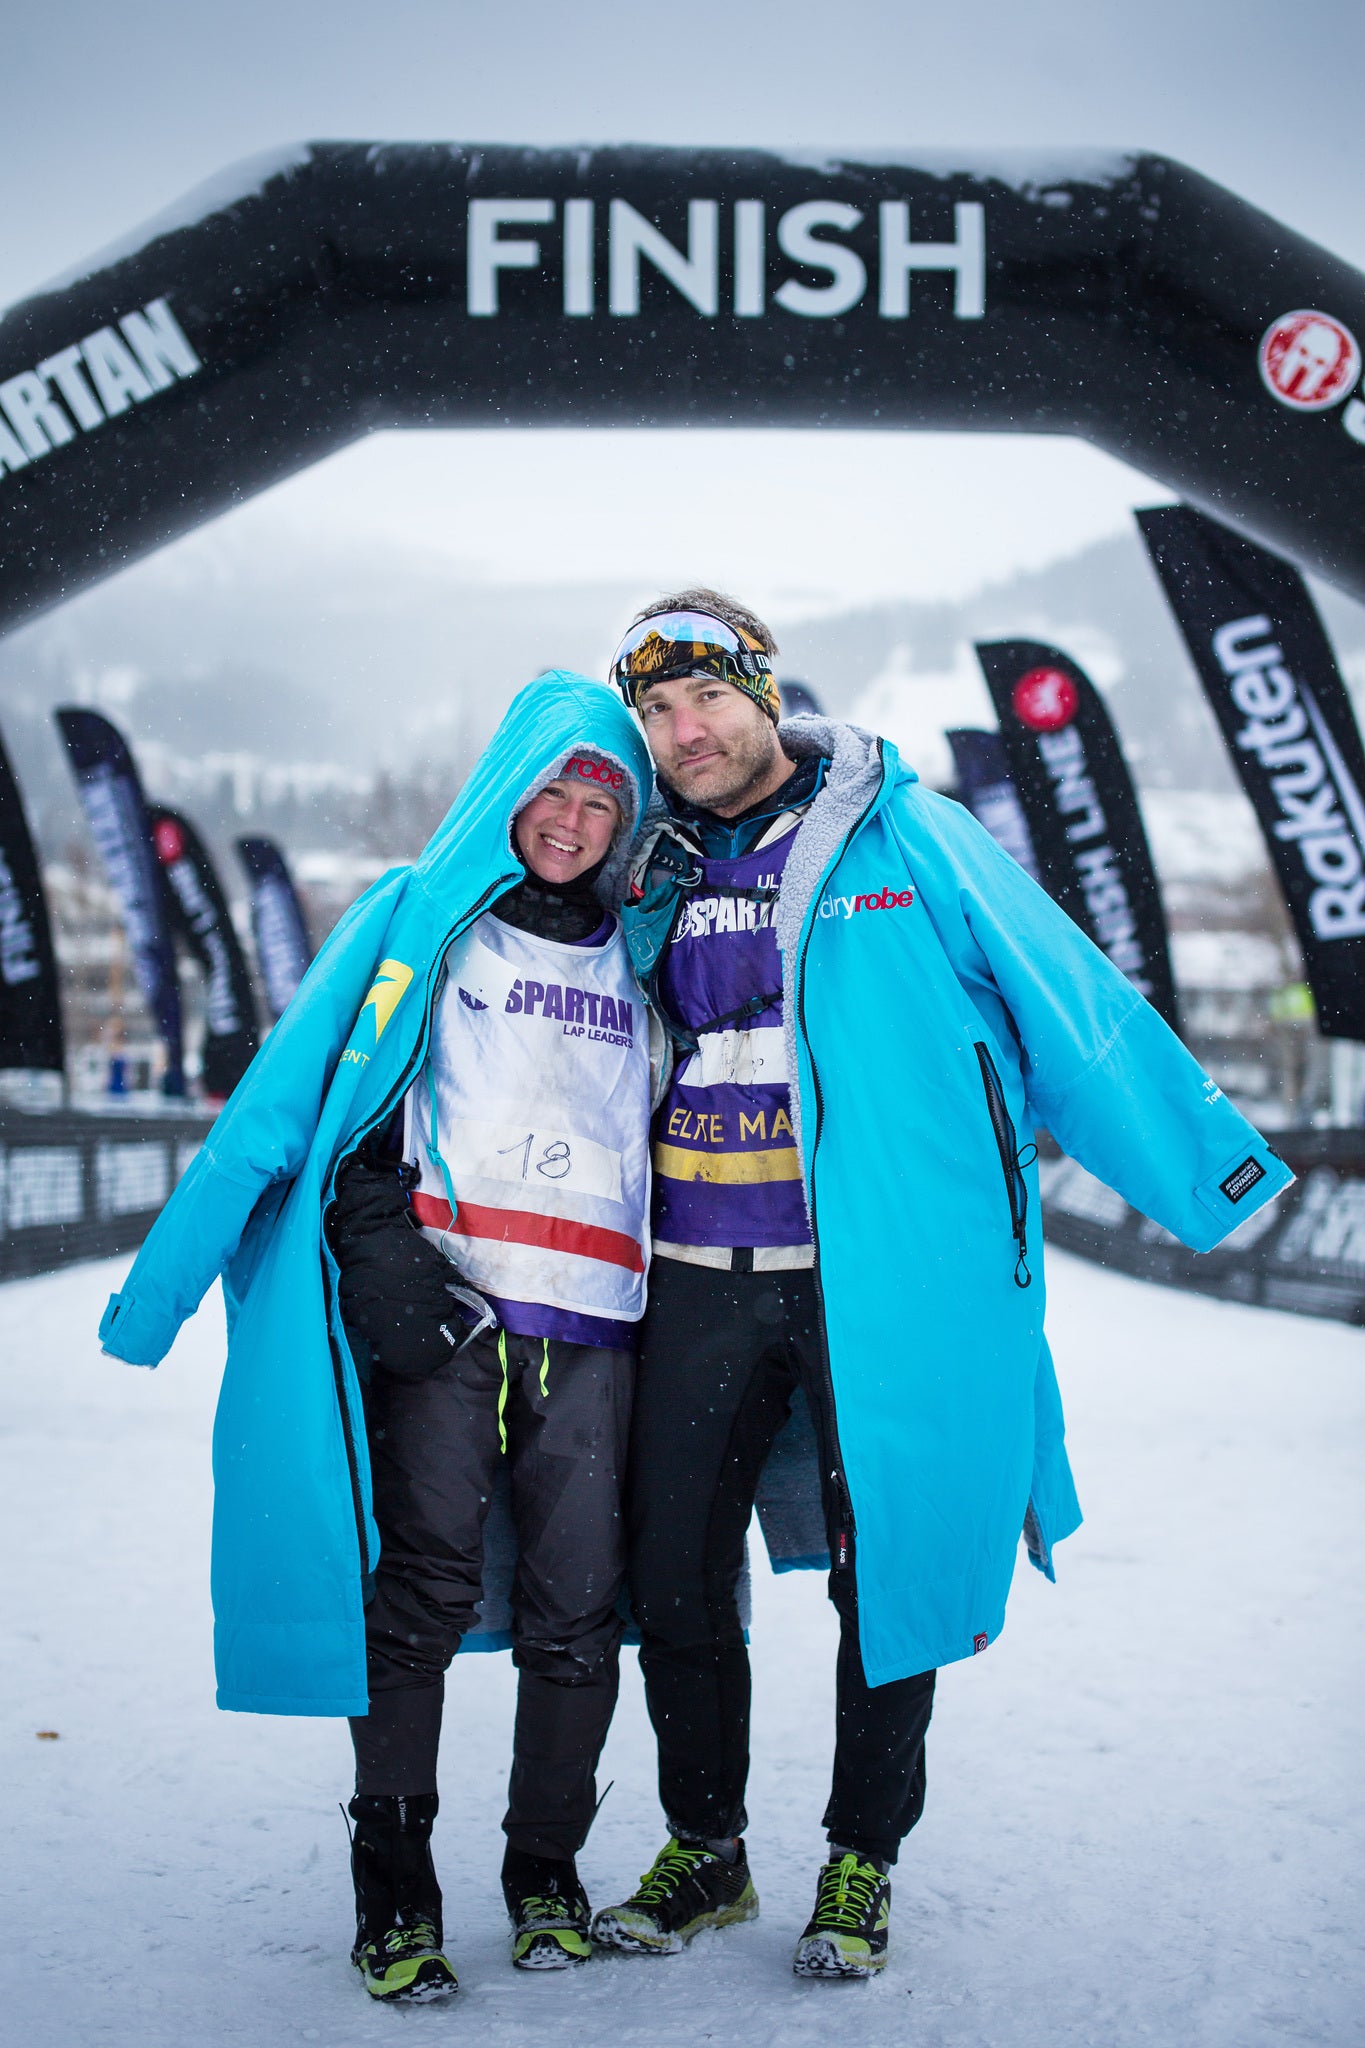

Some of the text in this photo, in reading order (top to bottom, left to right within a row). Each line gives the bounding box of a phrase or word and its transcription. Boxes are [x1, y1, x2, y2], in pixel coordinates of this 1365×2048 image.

[467, 198, 985, 318] FINISH
[564, 756, 623, 790] robe
[1037, 724, 1107, 843] LINE
[1212, 612, 1365, 942] Rakuten
[819, 886, 914, 920] dryrobe
[504, 979, 634, 1038] SPARTAN
[562, 1024, 634, 1049] LAP LEADERS
[339, 1049, 370, 1068] ENT
[497, 1133, 571, 1181] 18
[1229, 1165, 1260, 1196] ADVANCE
